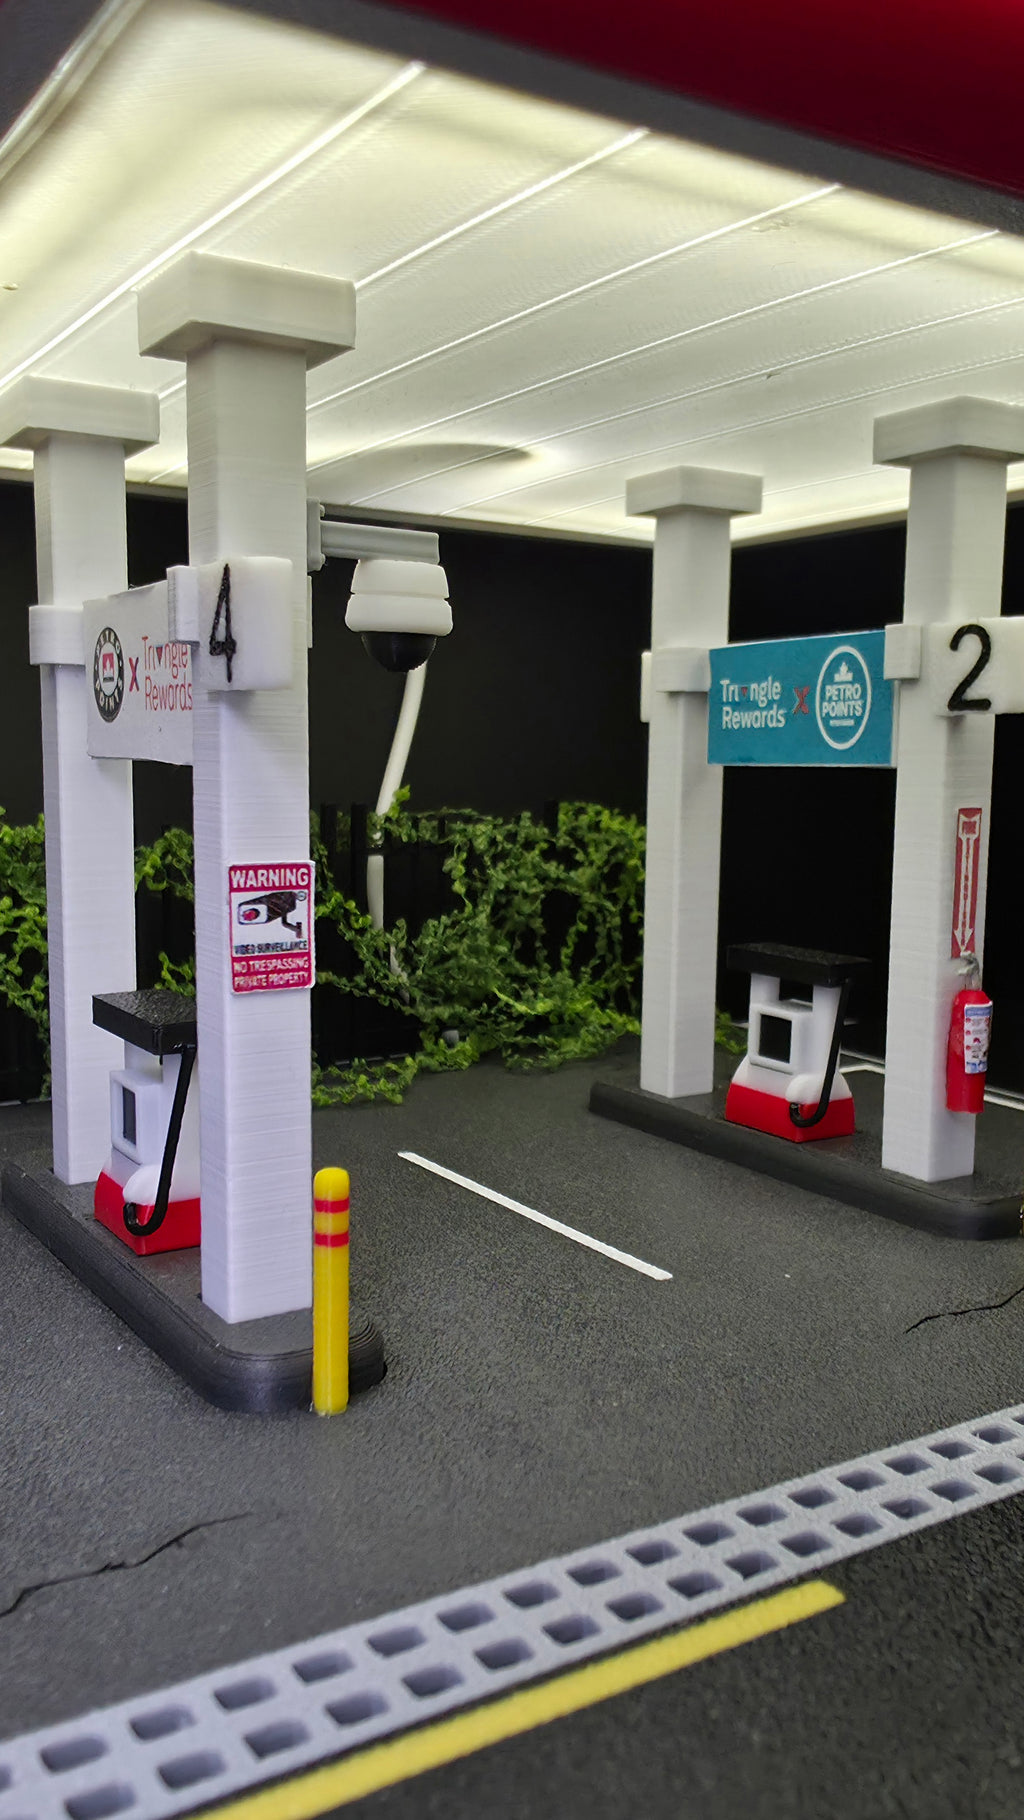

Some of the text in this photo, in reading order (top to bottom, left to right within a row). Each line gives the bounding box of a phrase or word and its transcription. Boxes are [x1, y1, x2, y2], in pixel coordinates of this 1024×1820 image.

[209, 563, 237, 683] 4
[947, 623, 992, 712] 2
[145, 672, 193, 711] Rewards
[825, 683, 862, 701] PETRO
[722, 705, 786, 730] Rewards
[822, 700, 864, 717] POINTS
[230, 867, 309, 889] WARNING
[233, 957, 309, 973] NO TRESPASSING
